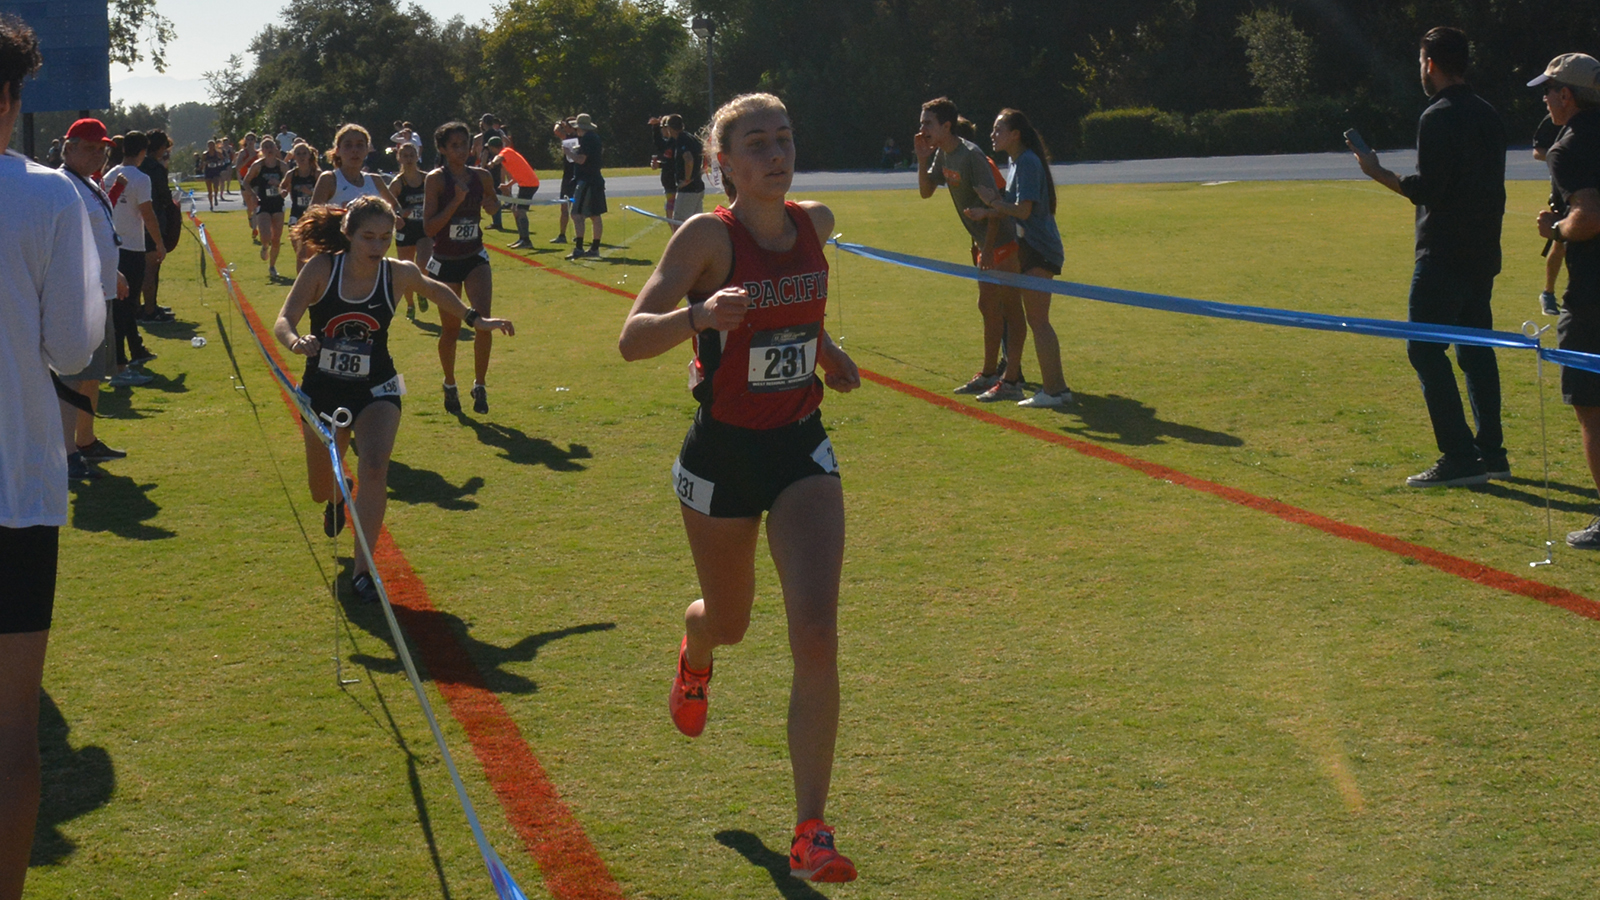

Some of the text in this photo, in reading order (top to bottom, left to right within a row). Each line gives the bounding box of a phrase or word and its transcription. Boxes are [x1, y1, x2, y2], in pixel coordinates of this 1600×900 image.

[456, 225, 475, 238] 287
[743, 270, 828, 309] PACIFIC
[329, 351, 361, 373] 136
[764, 344, 807, 380] 231
[382, 380, 397, 393] 136
[676, 473, 694, 502] 231
